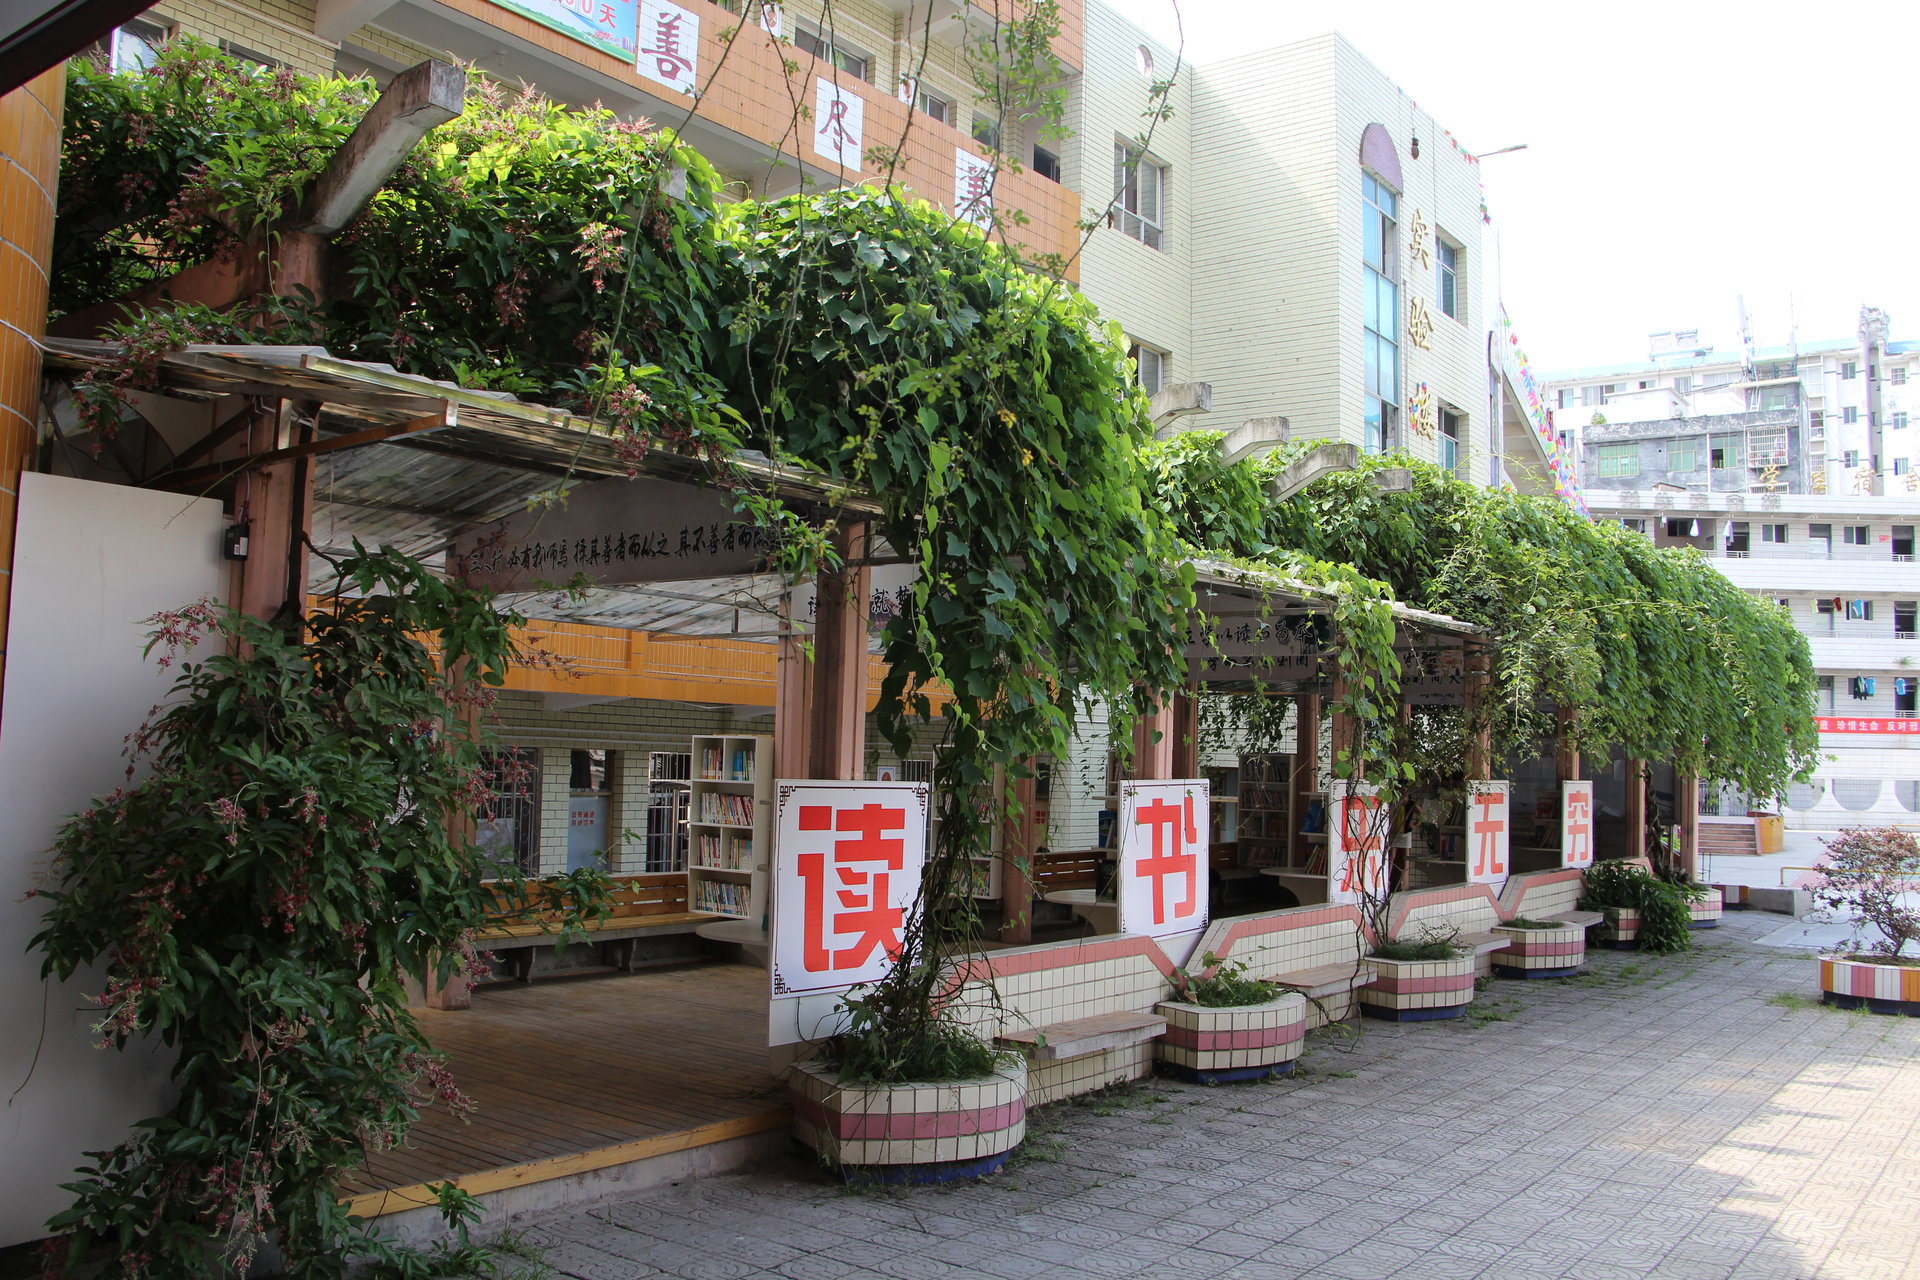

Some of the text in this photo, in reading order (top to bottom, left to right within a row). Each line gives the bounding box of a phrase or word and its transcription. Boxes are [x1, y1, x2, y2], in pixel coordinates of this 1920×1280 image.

[641, 12, 693, 81] 善
[818, 99, 860, 152] 尽
[1409, 207, 1435, 441] 实验楼
[1759, 463, 1920, 493] 学生宿舍
[1836, 719, 1879, 732] 珍惜生命
[1135, 795, 1197, 925] 书
[1474, 792, 1505, 877] 无
[1567, 789, 1589, 864] 穷
[797, 803, 906, 973] 读
